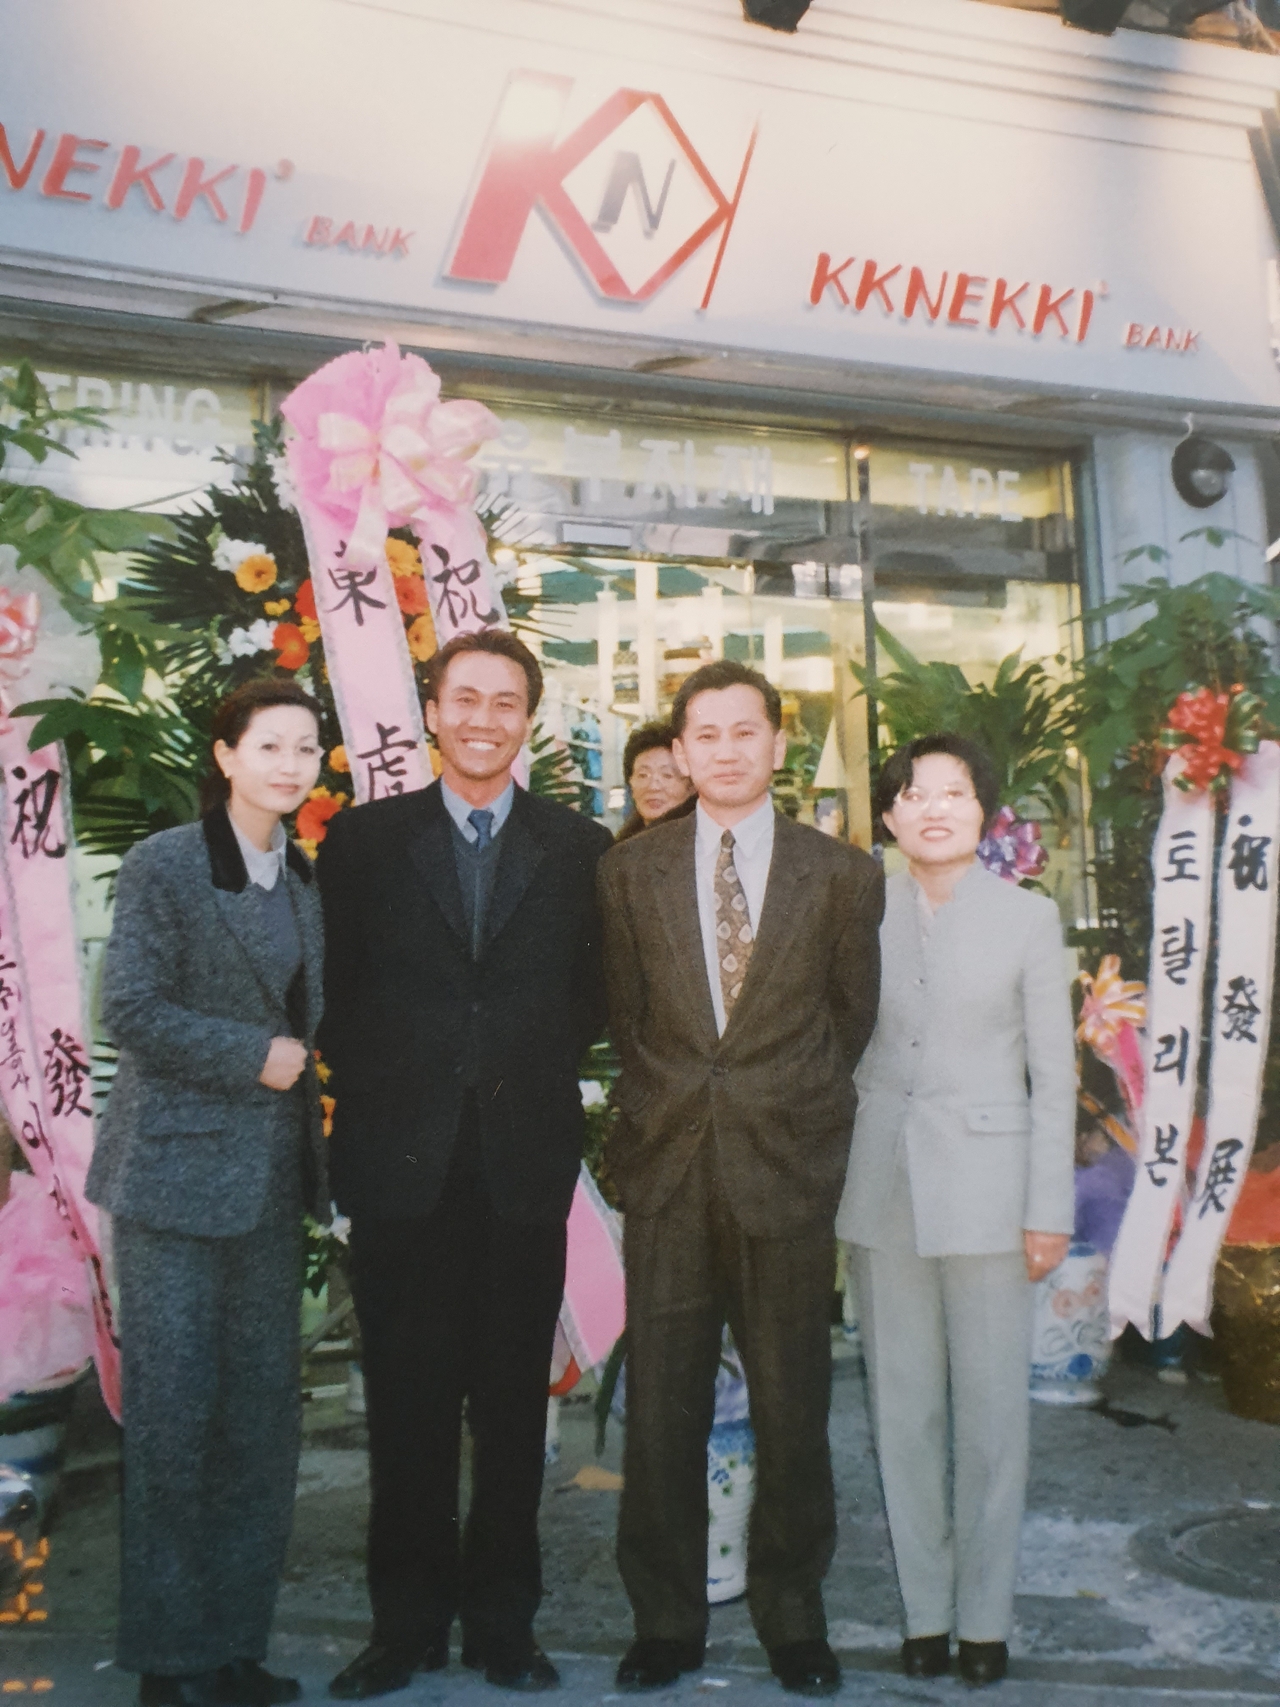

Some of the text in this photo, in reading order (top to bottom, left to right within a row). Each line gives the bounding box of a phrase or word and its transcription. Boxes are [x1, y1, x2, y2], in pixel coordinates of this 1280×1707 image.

[304, 214, 416, 257] BANK
[809, 251, 1201, 351] KKNEKKI BANK
[908, 462, 1024, 523] TAPE
[432, 543, 500, 628] 祝
